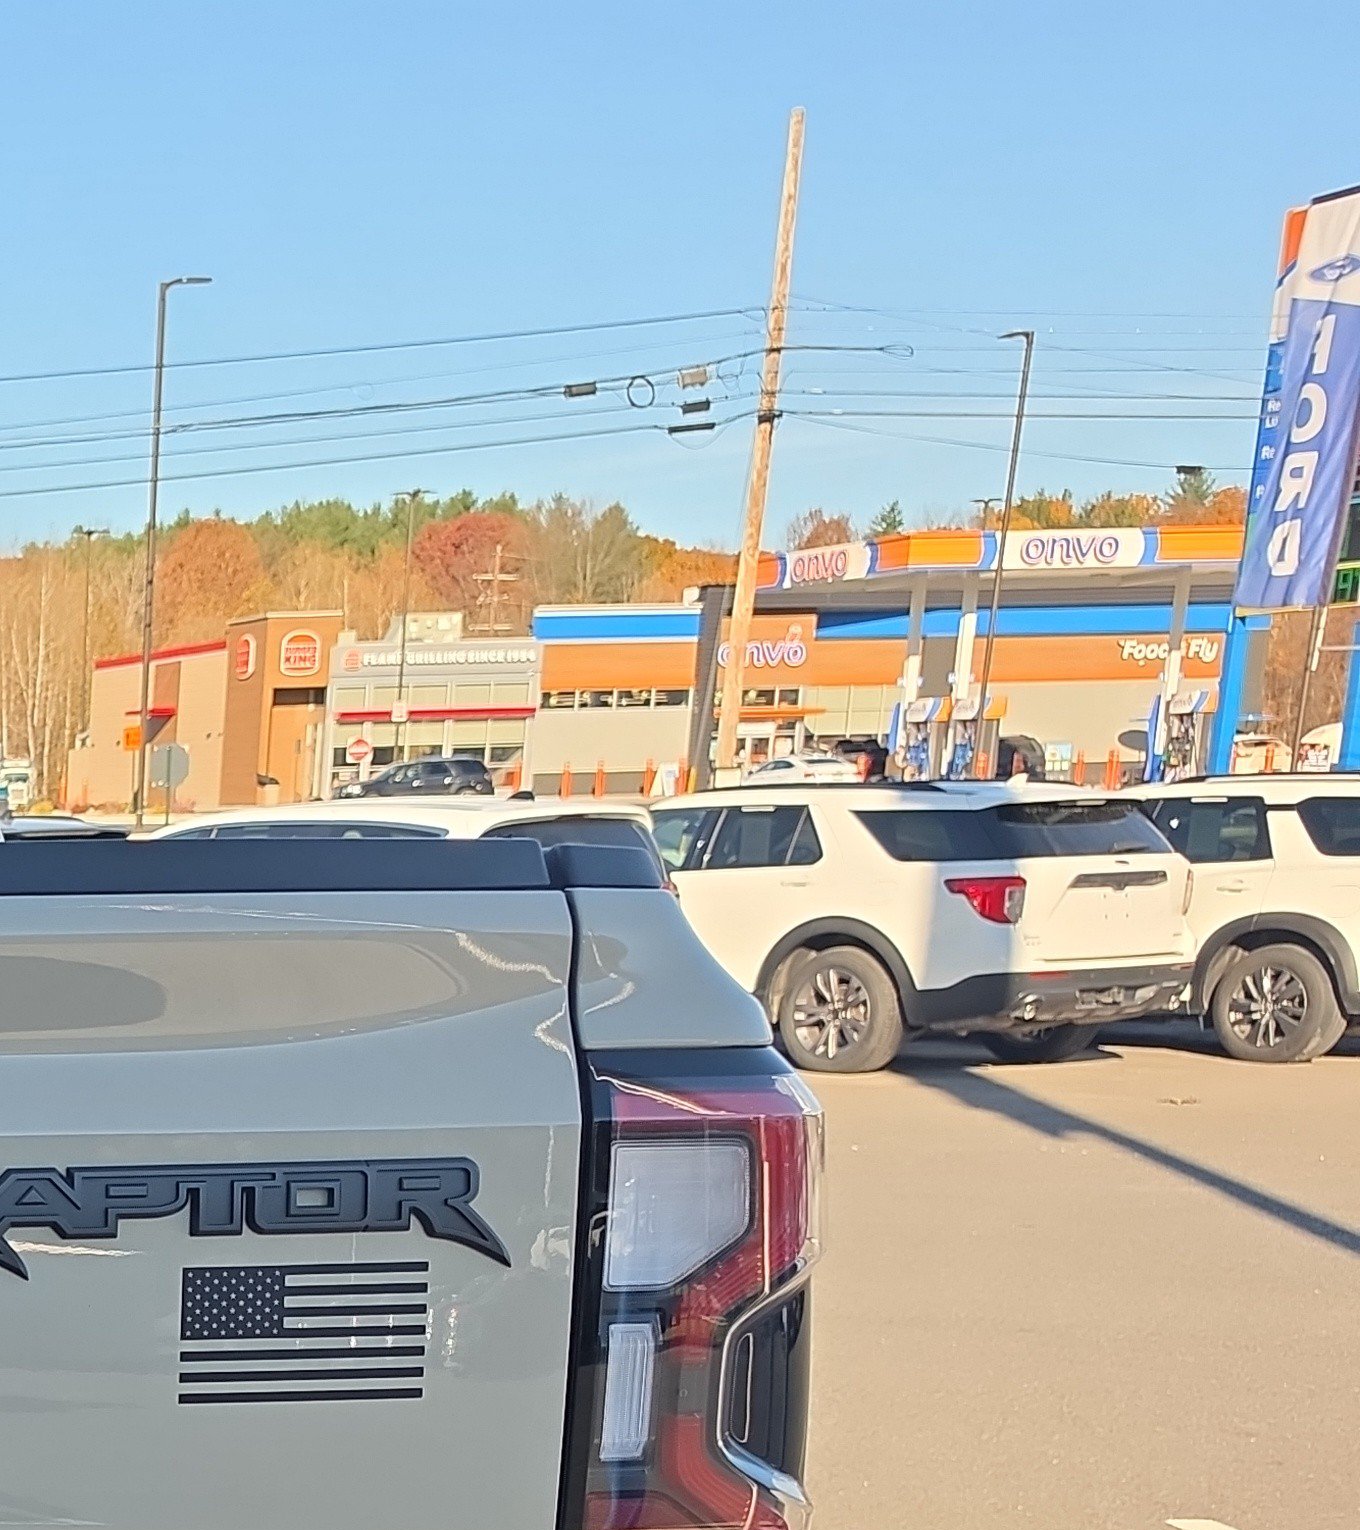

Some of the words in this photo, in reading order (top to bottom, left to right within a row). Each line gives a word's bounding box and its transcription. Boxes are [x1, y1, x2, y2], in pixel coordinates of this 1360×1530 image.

[1021, 528, 1120, 568] onvo
[791, 546, 849, 583] onvo
[284, 655, 317, 667] KING
[1187, 635, 1220, 663] Fly
